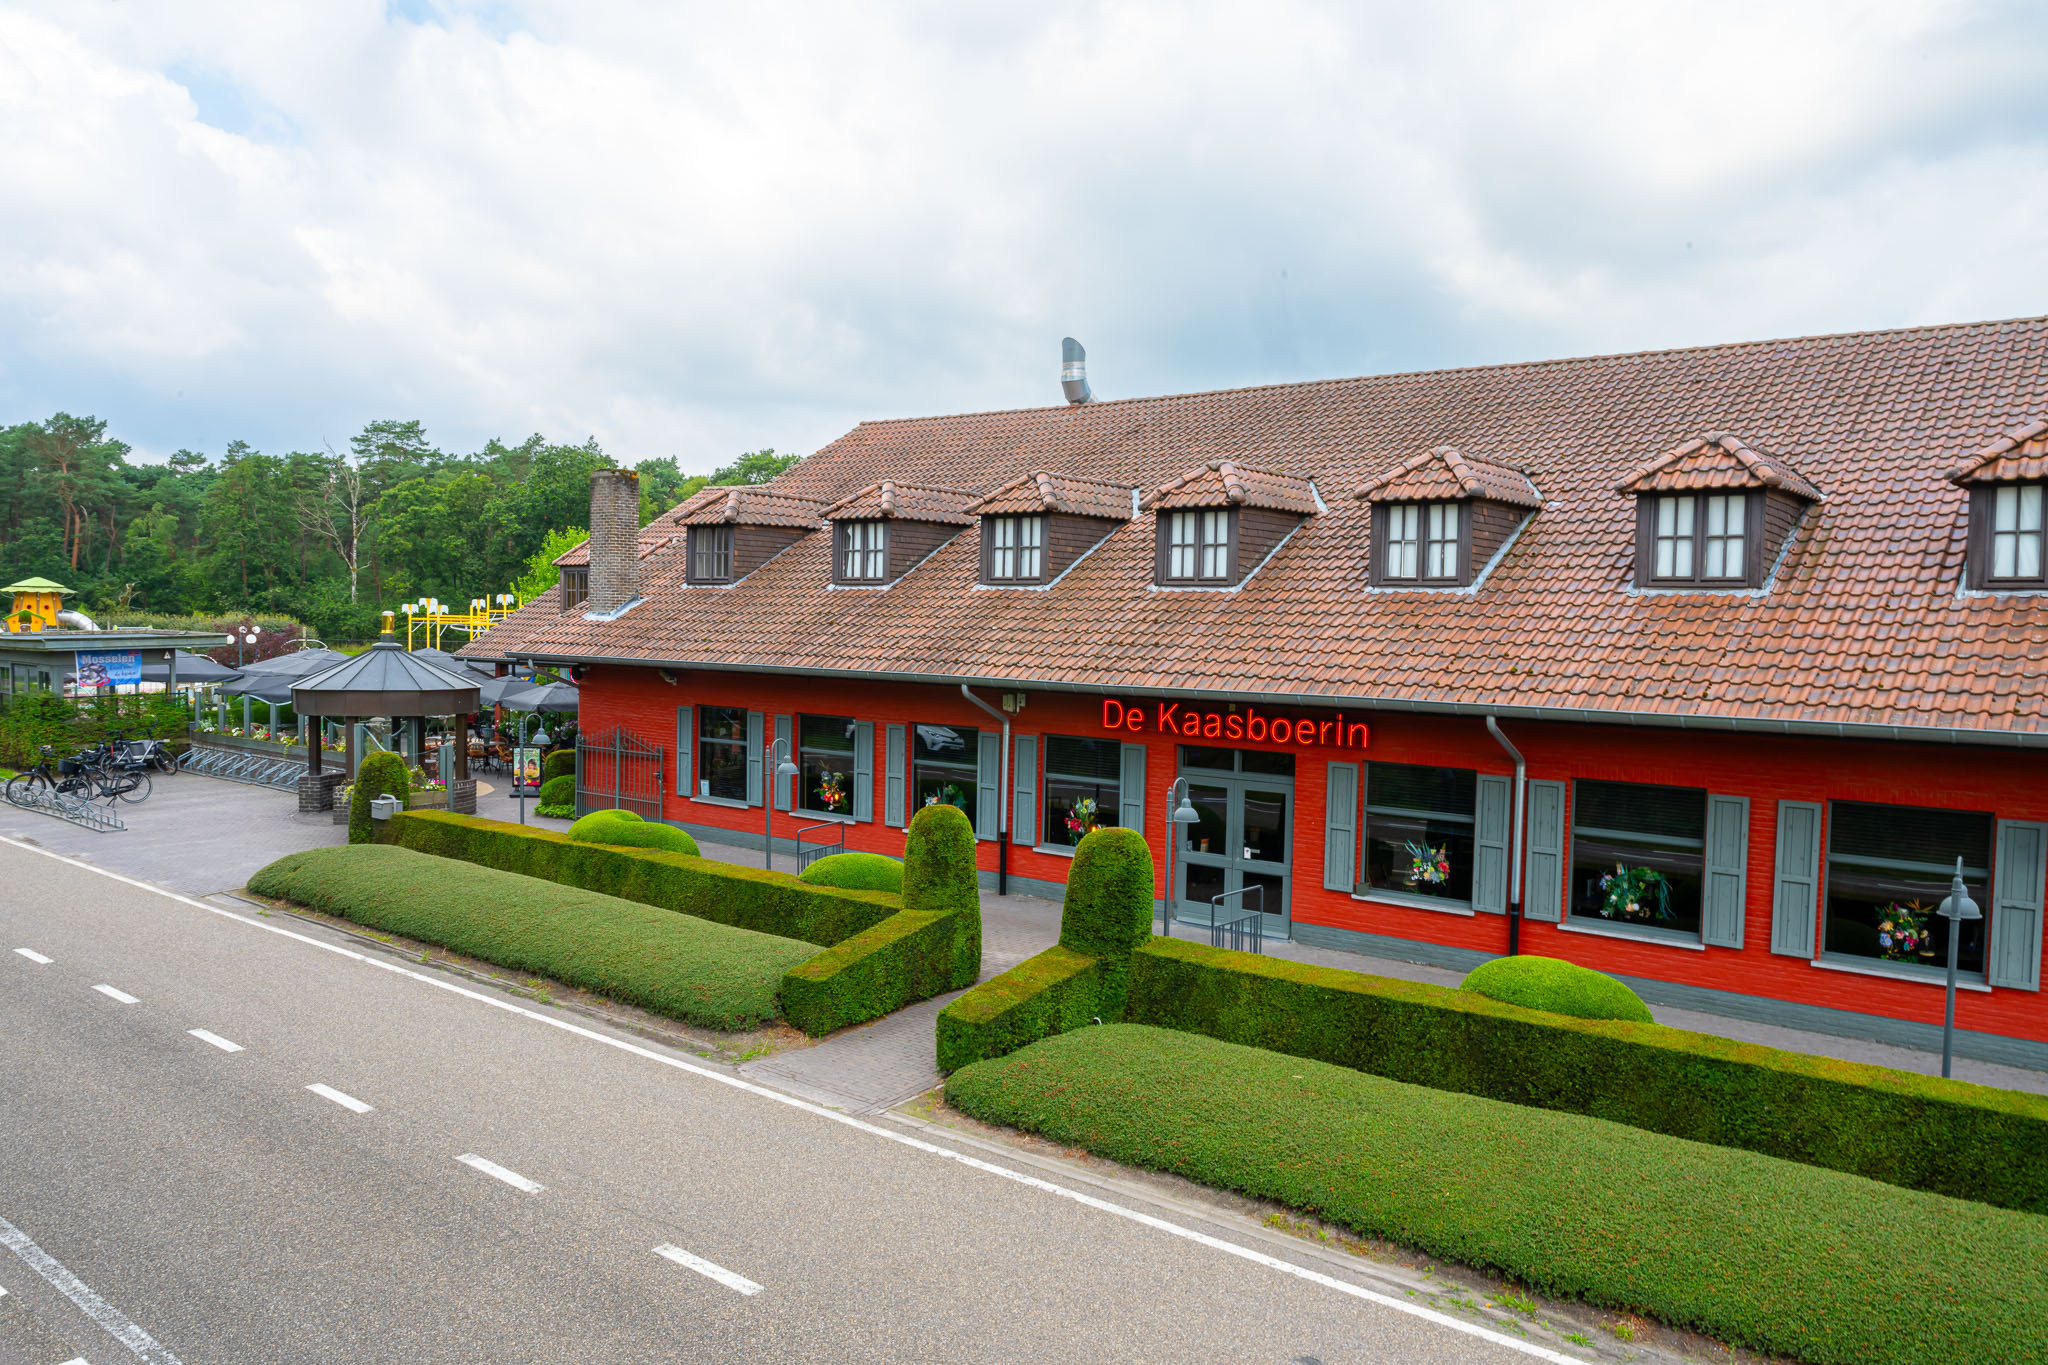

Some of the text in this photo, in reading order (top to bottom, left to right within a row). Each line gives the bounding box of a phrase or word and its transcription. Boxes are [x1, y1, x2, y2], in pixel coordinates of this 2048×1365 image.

[81, 653, 135, 665] Mosselen
[1102, 698, 1370, 748] De Kaasboerin
